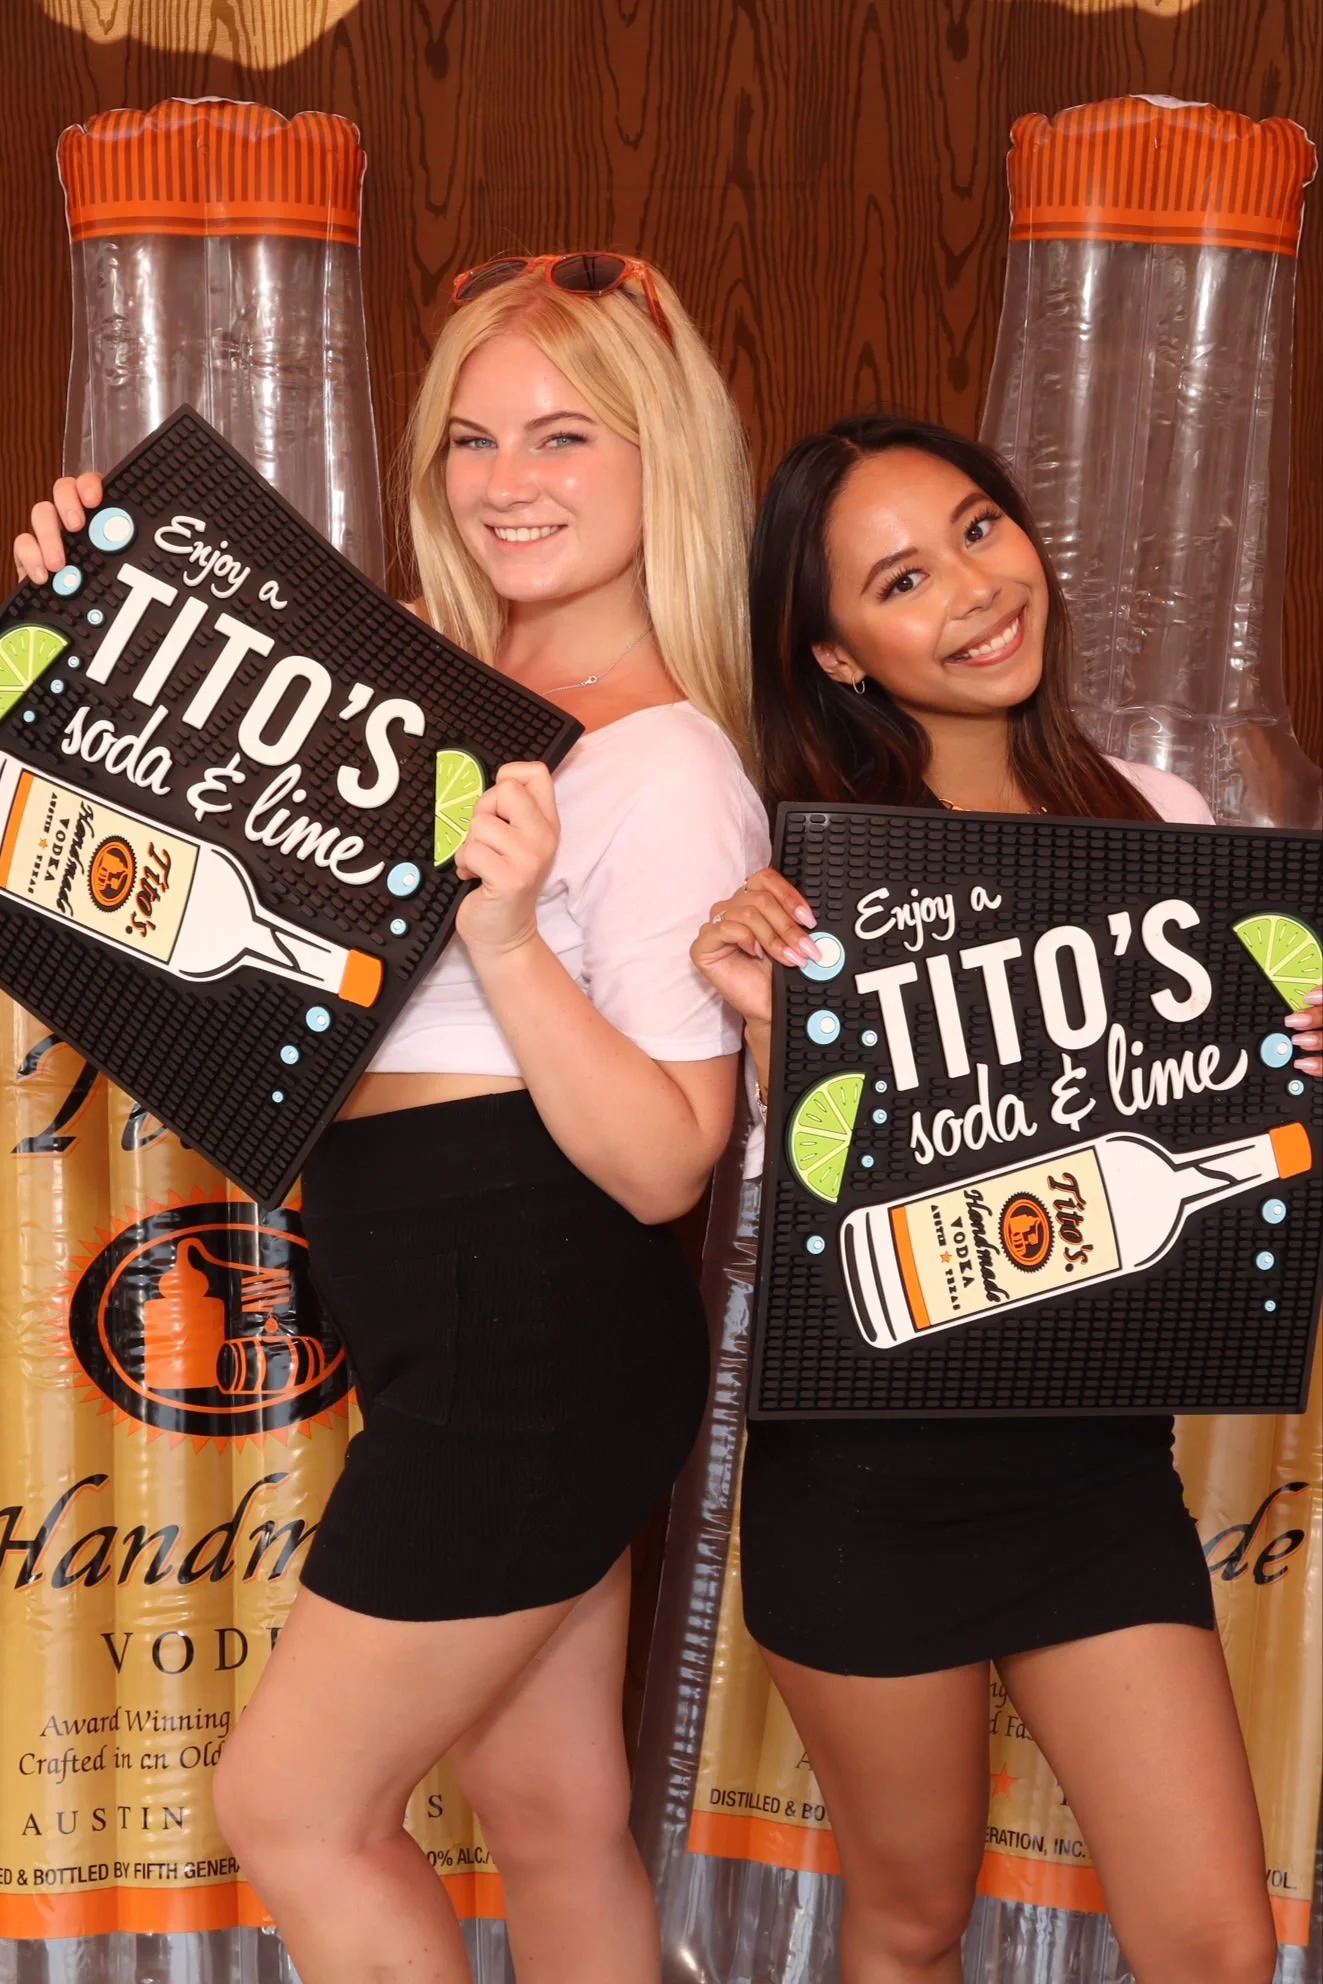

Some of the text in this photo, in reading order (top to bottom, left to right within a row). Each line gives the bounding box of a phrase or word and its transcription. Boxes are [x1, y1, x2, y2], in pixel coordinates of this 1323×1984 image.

[154, 515, 287, 610] Enjoy a
[85, 563, 426, 810] TITO'S
[61, 705, 386, 885] soda & lime
[44, 818, 70, 882] VODKA
[56, 800, 95, 917] Handmade
[854, 886, 1002, 952] Enjoy a
[854, 898, 1213, 1092] TITO'S
[909, 1022, 1249, 1166] soda & lime
[951, 1216, 975, 1288] VODKA
[963, 1189, 1010, 1303] Handmade
[40, 1706, 122, 1737] Award
[125, 1708, 231, 1738] Winning
[19, 1745, 108, 1785] Crafted
[114, 1747, 131, 1769] in
[140, 1752, 169, 1770] an
[22, 1806, 185, 1836] AUSTIN
[710, 1788, 780, 1814] DISTILLED
[785, 1800, 796, 1817] &
[17, 1869, 28, 1885] &
[33, 1863, 109, 1886] BOTTLED
[113, 1861, 130, 1878] BY
[134, 1862, 178, 1880] FIFTH
[1054, 1838, 1086, 1858] INC.
